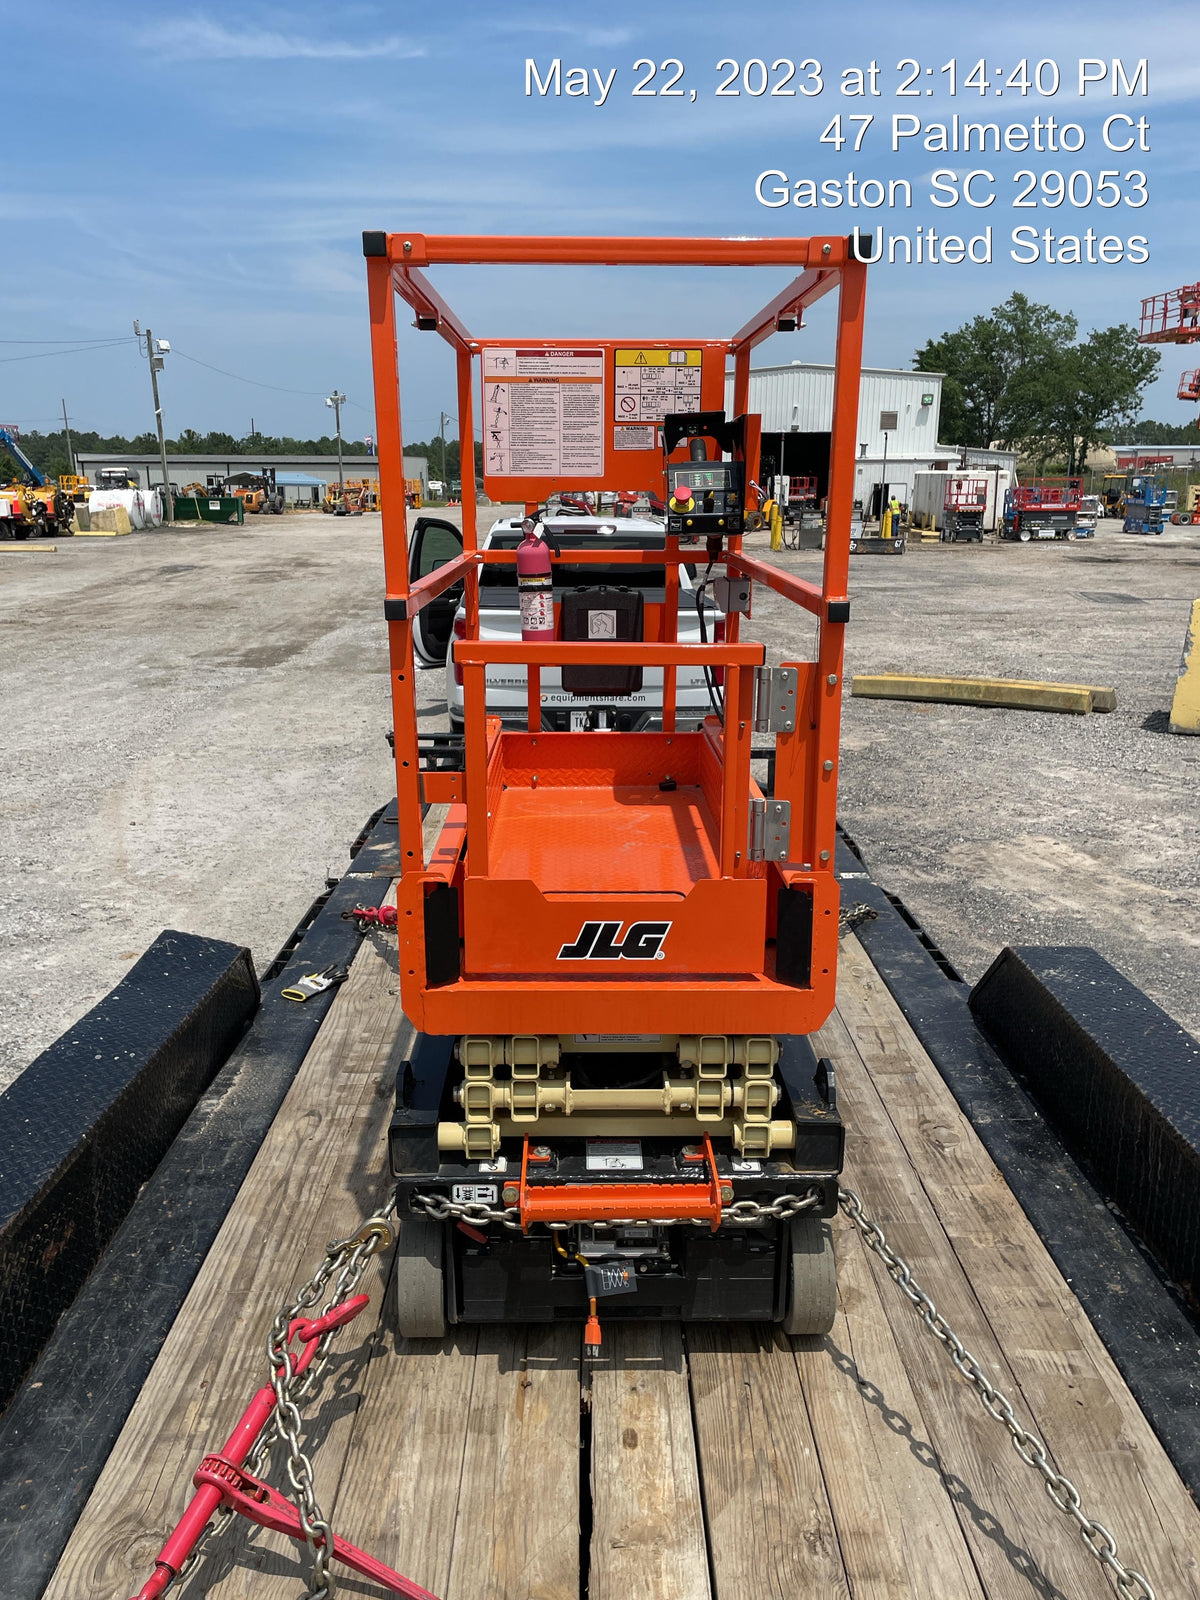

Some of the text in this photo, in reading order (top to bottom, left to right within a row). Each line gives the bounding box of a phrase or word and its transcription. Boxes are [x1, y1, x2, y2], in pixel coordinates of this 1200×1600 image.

[894, 539, 903, 548] 67
[550, 693, 646, 703] equipmentshare.com
[556, 921, 673, 960] JLG
